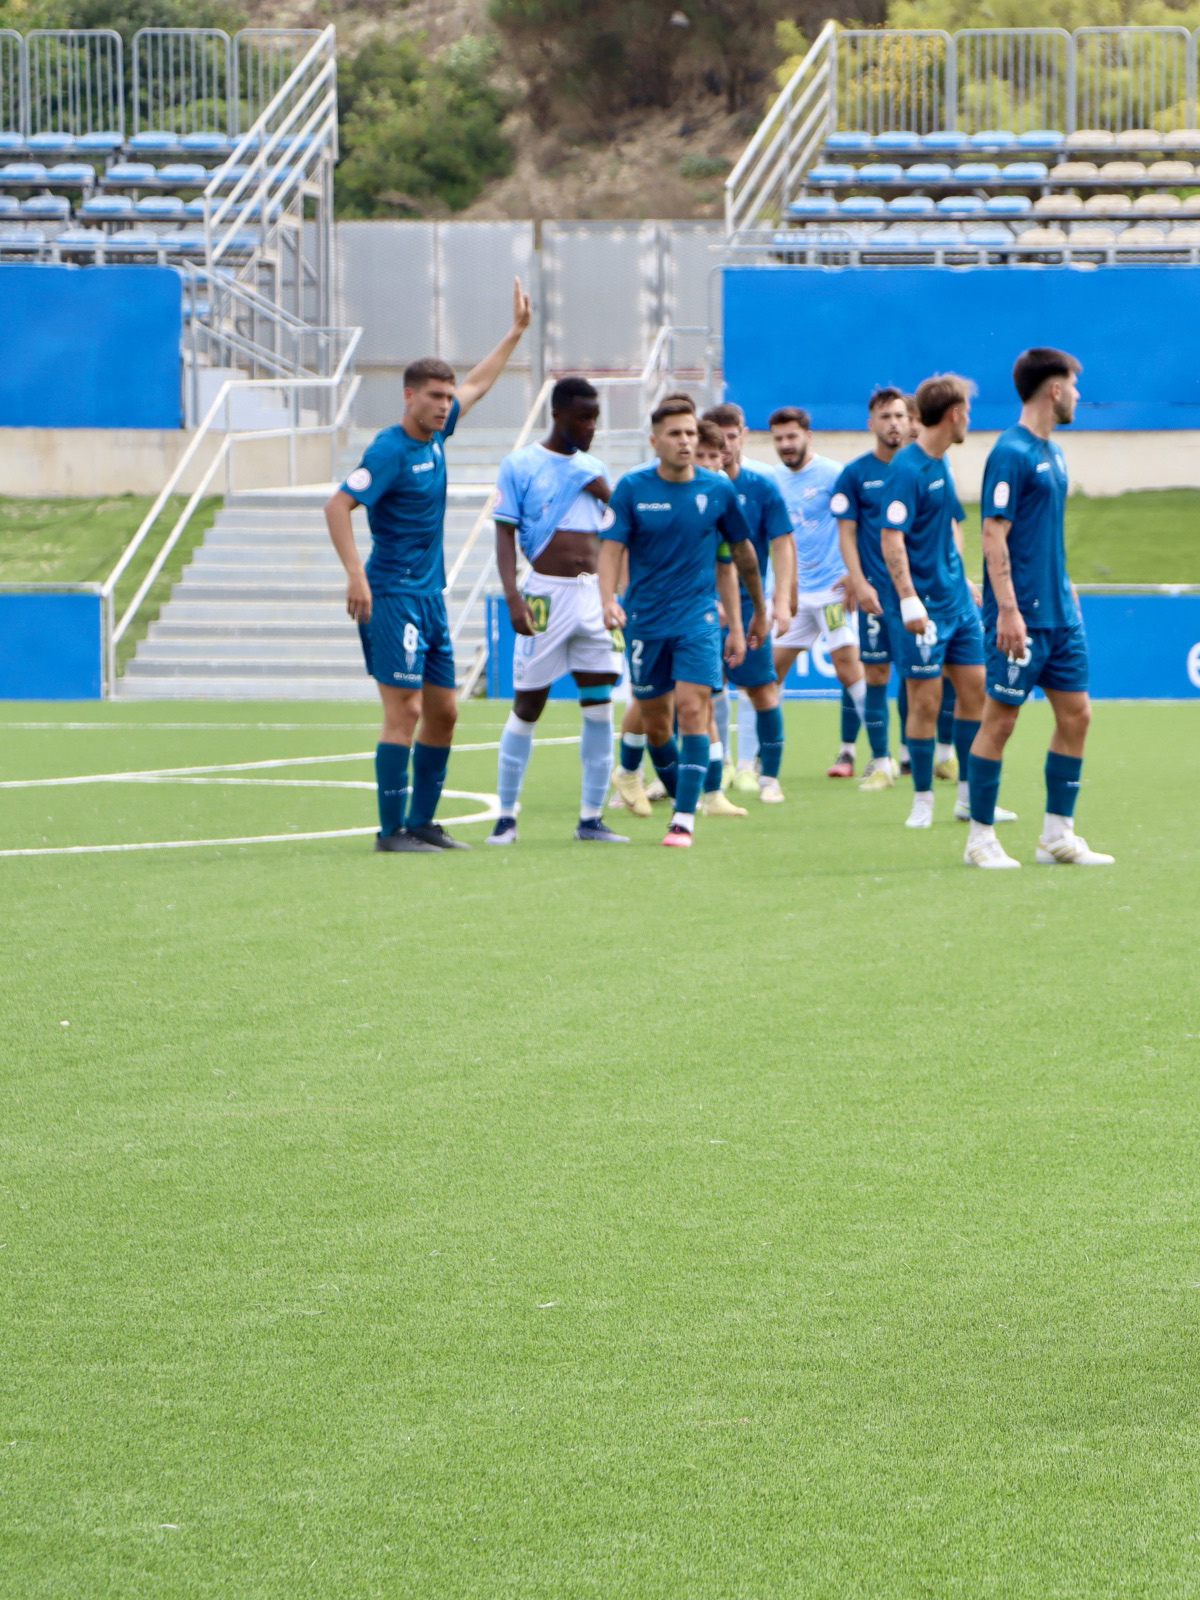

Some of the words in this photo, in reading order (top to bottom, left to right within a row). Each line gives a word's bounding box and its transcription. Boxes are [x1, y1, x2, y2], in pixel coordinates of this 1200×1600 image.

[402, 622, 418, 653] 8
[866, 612, 880, 637] 5
[631, 639, 644, 665] 2
